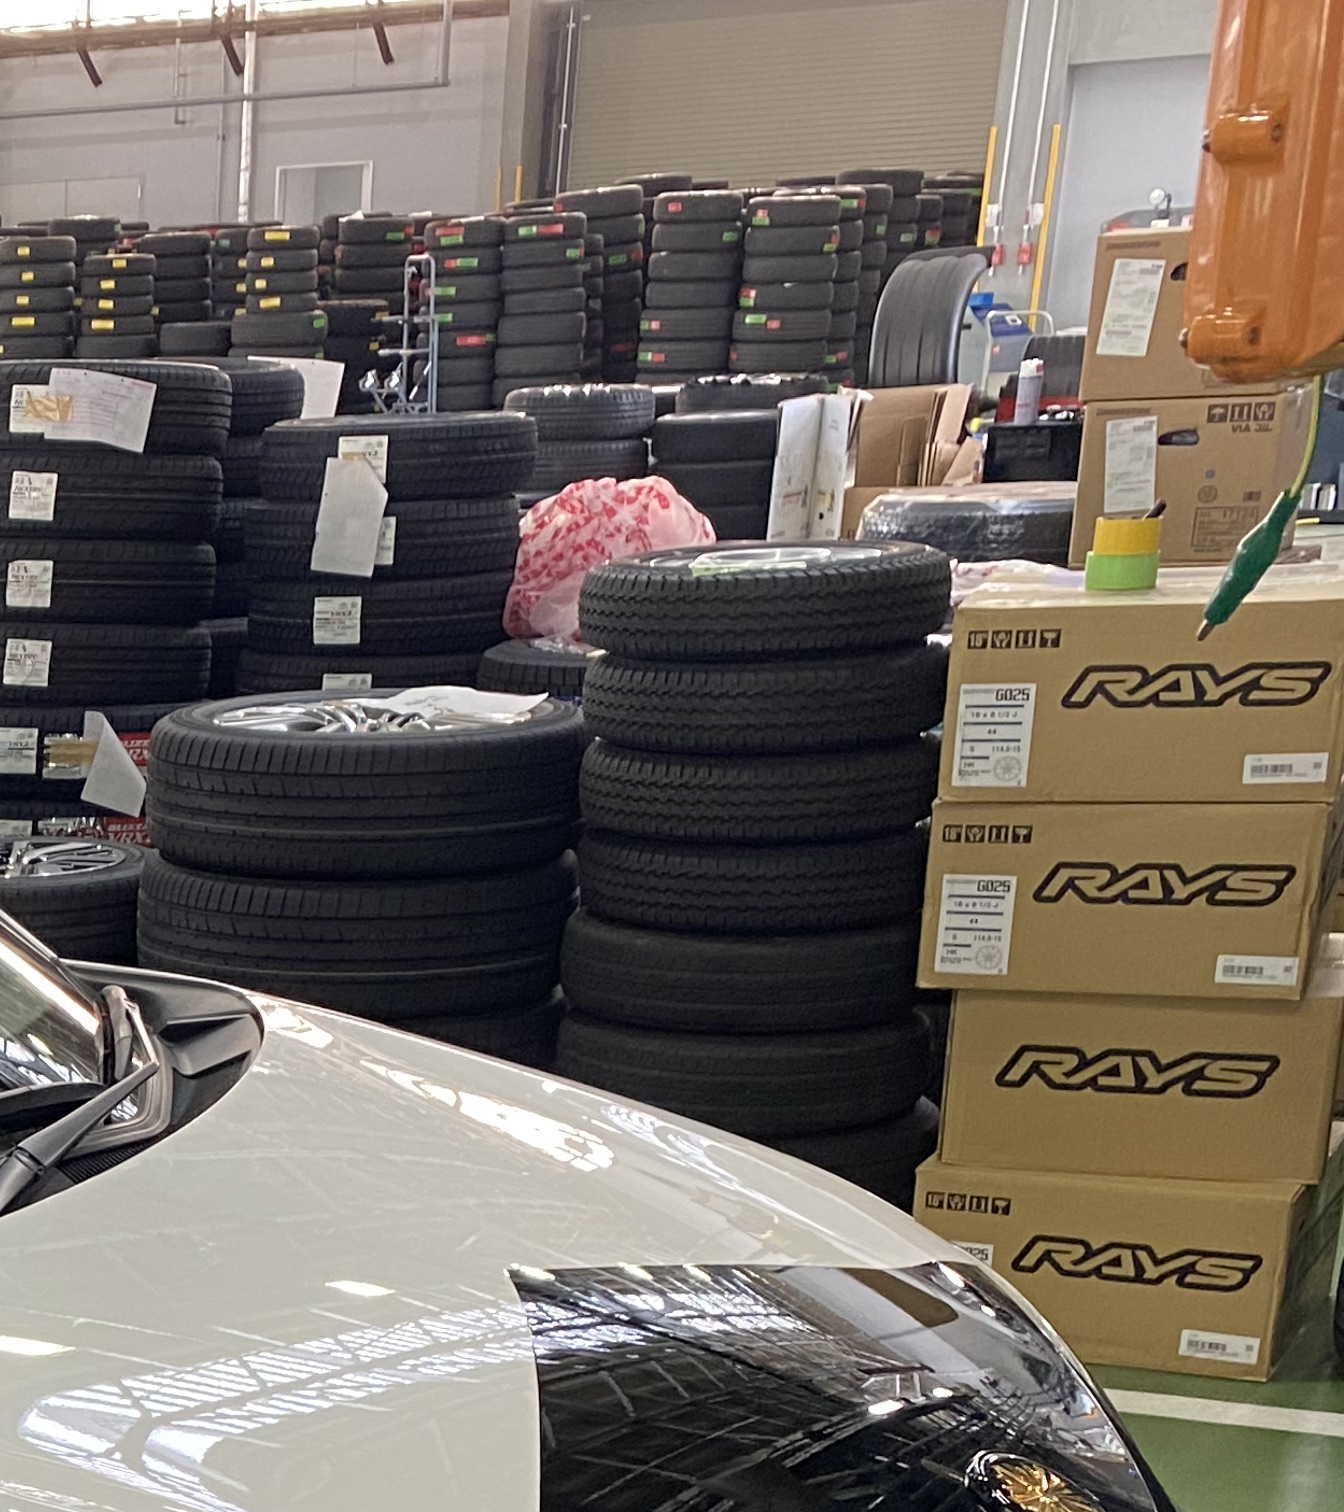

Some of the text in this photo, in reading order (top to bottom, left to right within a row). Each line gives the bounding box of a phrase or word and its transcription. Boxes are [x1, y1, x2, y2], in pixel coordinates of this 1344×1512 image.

[1061, 661, 1332, 708] RAYS
[1032, 861, 1297, 907] RAYS
[996, 1044, 1281, 1099] RAYS
[1011, 1234, 1263, 1292] RAYS
